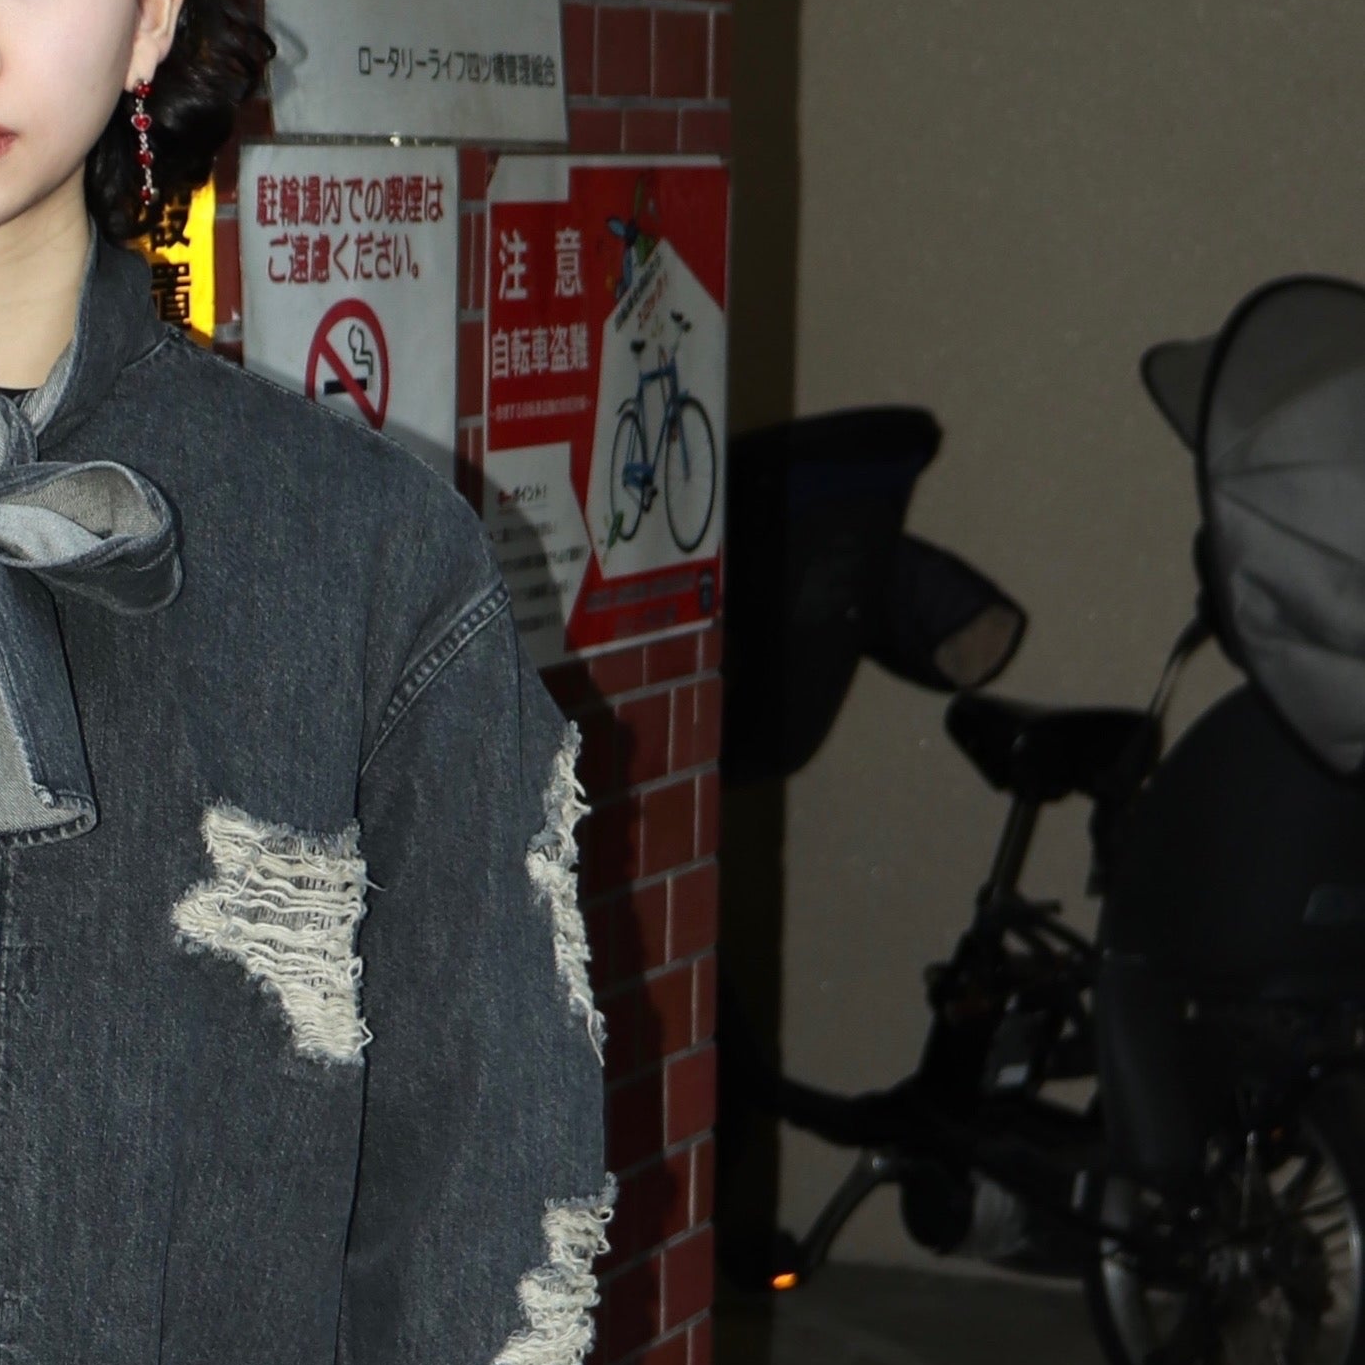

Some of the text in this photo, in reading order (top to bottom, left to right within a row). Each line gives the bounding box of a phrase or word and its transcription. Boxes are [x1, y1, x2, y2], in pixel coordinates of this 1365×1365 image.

[256, 174, 443, 227] 駐輪場内での喫煙は
[267, 232, 419, 284] ご遠慮ください。
[498, 227, 584, 301] 注意
